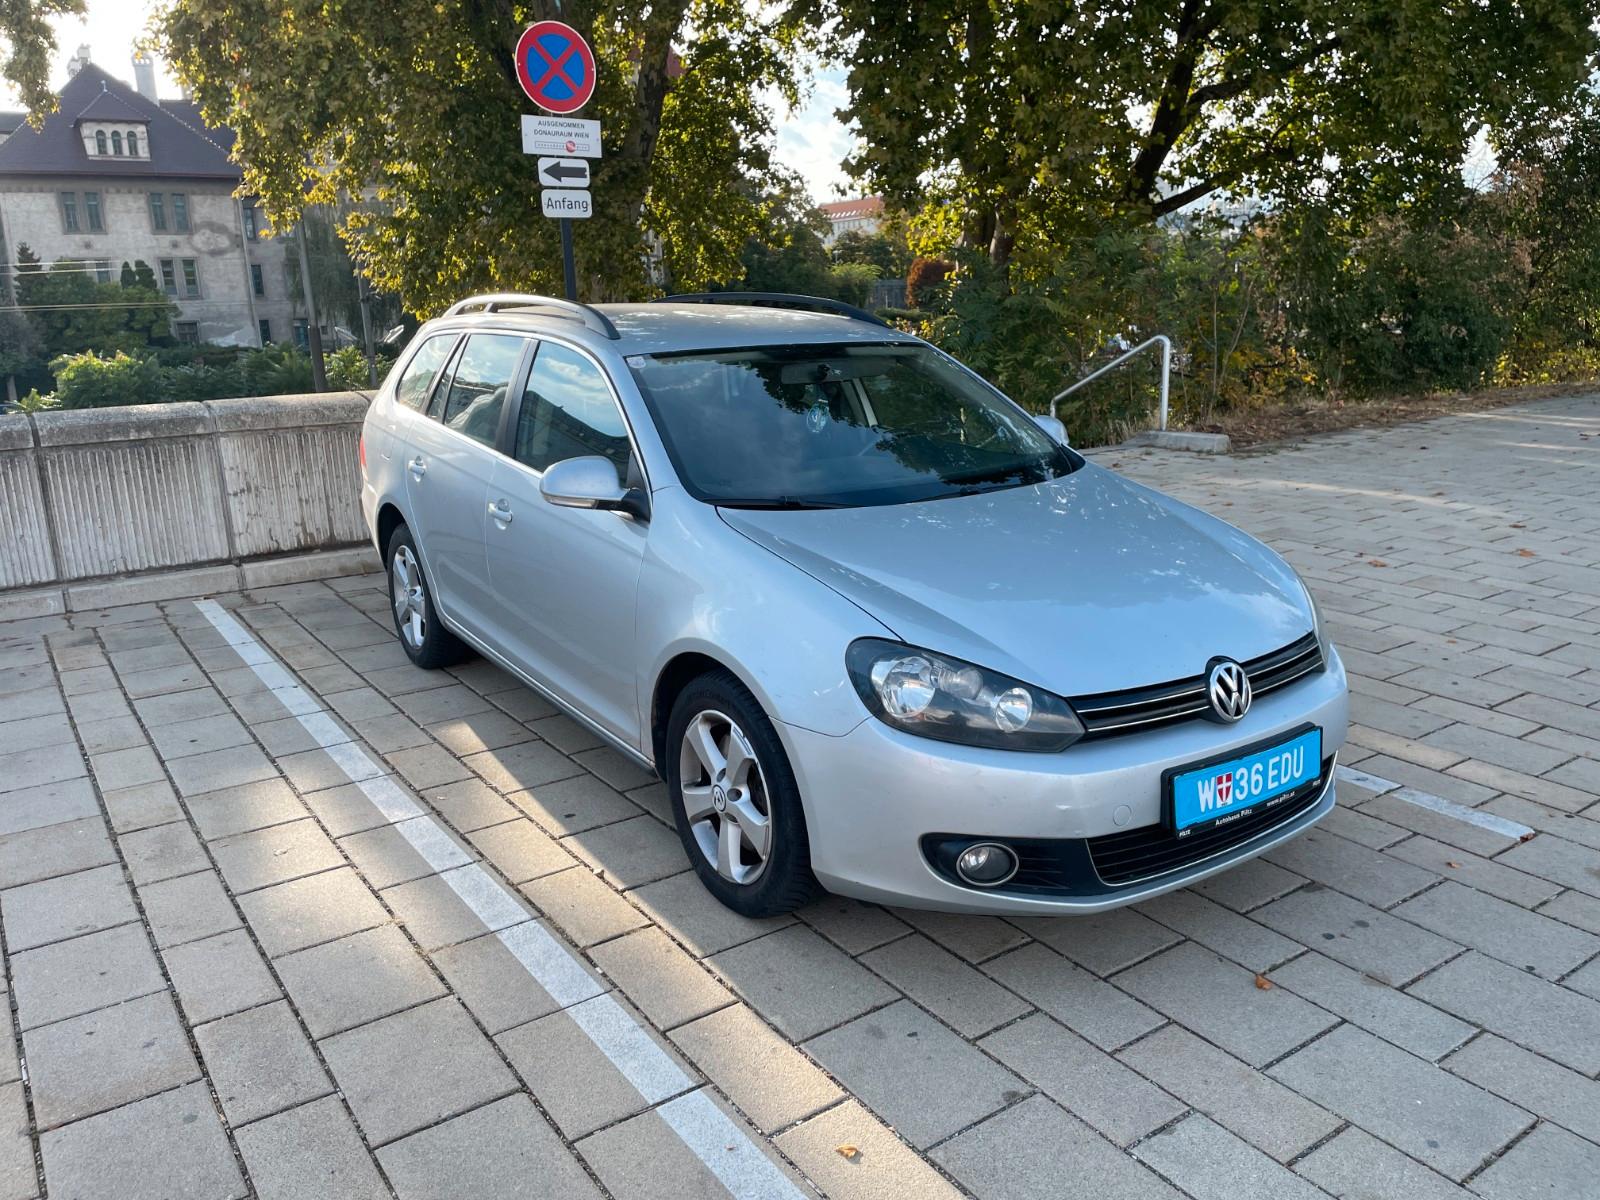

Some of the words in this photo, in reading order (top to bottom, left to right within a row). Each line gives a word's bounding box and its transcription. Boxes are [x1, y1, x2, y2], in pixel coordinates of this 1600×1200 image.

[537, 120, 585, 129] AUSGENOMMEN
[533, 129, 573, 137] DONAURAUM
[574, 131, 589, 139] WIEN
[546, 197, 588, 212] Anfang
[1211, 662, 1251, 720] VW
[1197, 776, 1216, 813] W
[1235, 762, 1263, 800] 36
[1267, 745, 1304, 790] EDU
[1215, 813, 1241, 826] Autohaus
